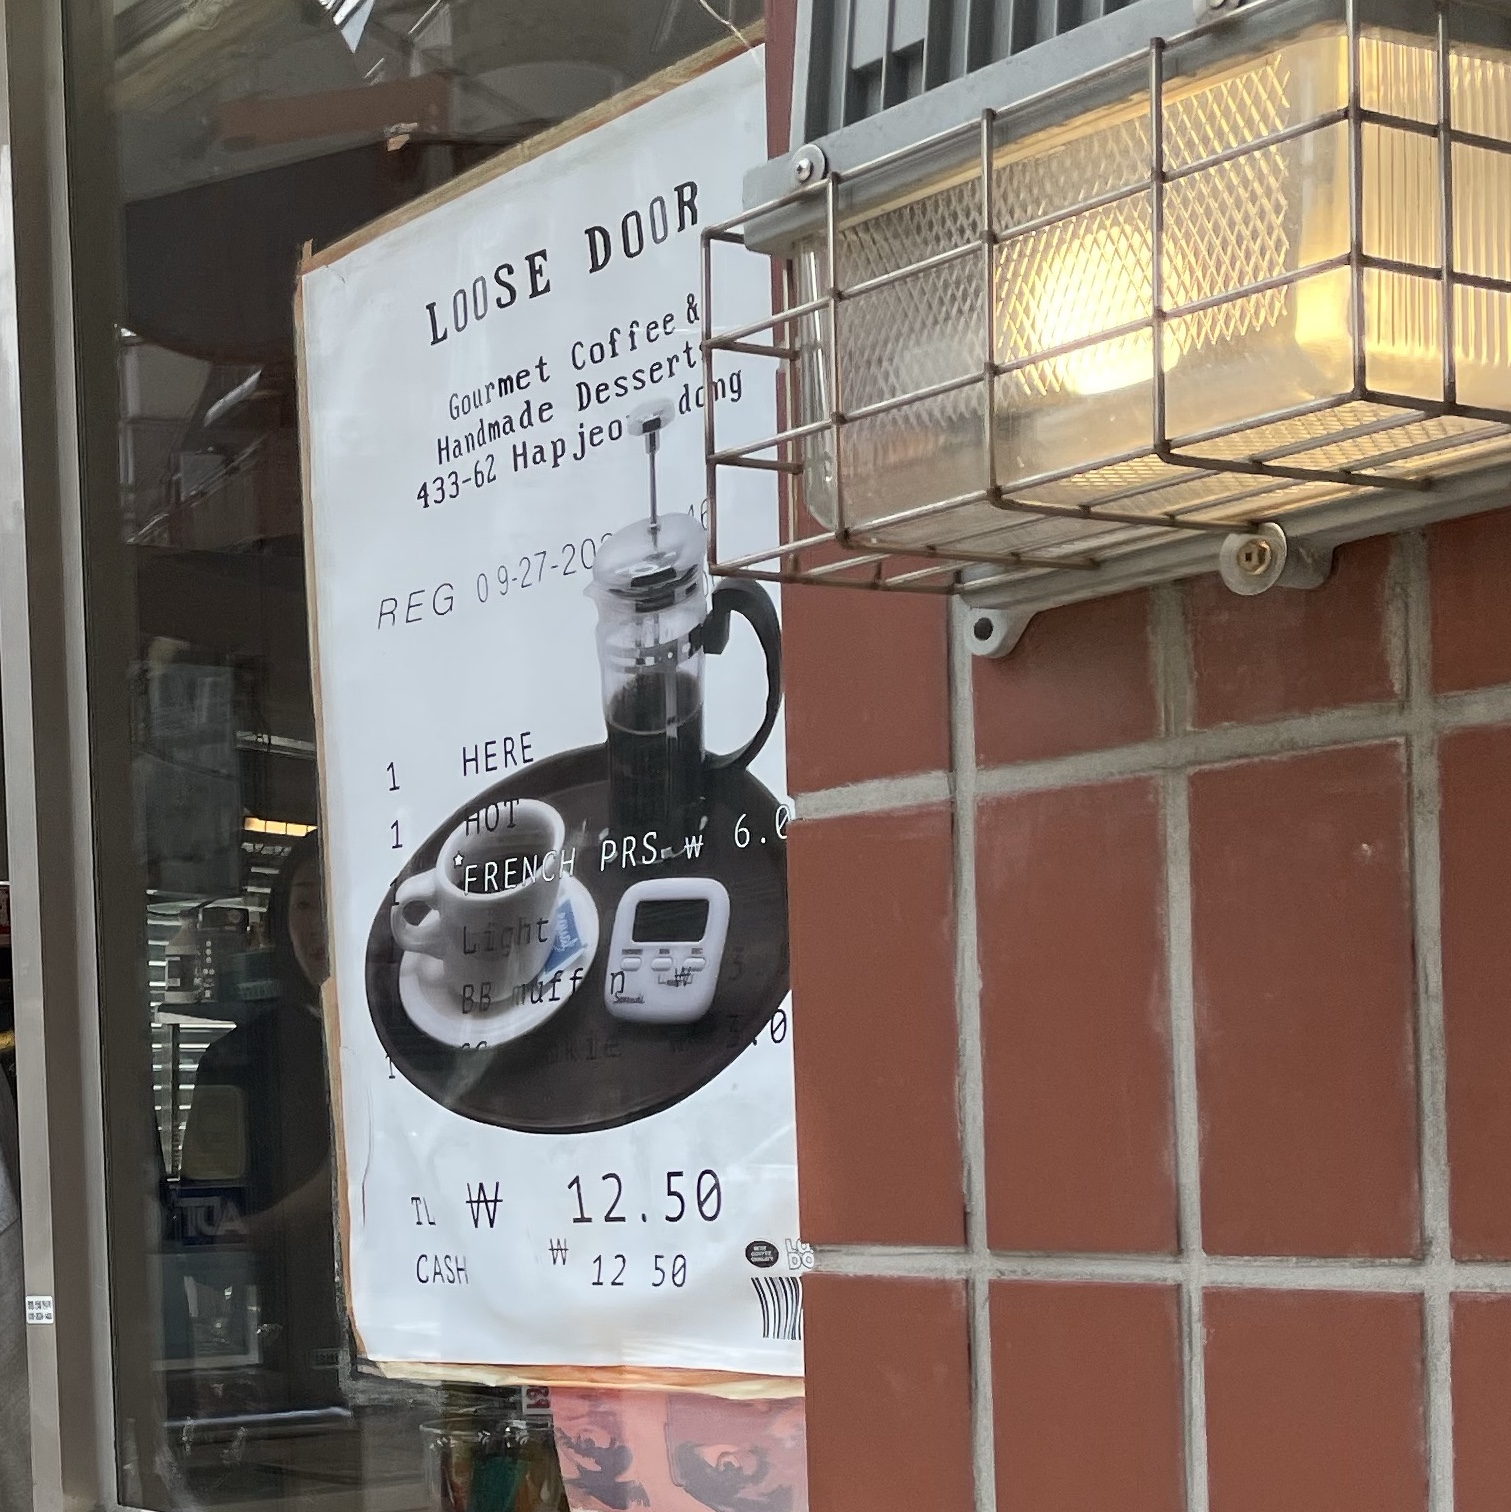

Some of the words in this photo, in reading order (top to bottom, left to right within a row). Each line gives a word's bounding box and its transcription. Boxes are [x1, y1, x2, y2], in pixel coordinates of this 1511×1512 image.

[426, 249, 551, 346] LOOSE
[585, 181, 698, 274] DOOR
[449, 356, 551, 421] Gourmet
[571, 312, 676, 371] Coffee
[687, 293, 700, 325] &
[437, 400, 554, 466] Handmade
[577, 340, 705, 412] Dessert
[416, 454, 498, 509] 433-62
[378, 583, 455, 630] REG
[386, 761, 401, 792] 1
[462, 731, 535, 777] HERE
[390, 820, 404, 849] 1
[464, 799, 520, 837] HOT
[463, 846, 576, 896] FRENCH
[512, 966, 625, 1007] muffn
[410, 1196, 437, 1227] TL
[567, 1168, 723, 1225] 12.50
[416, 1254, 470, 1285] CASH
